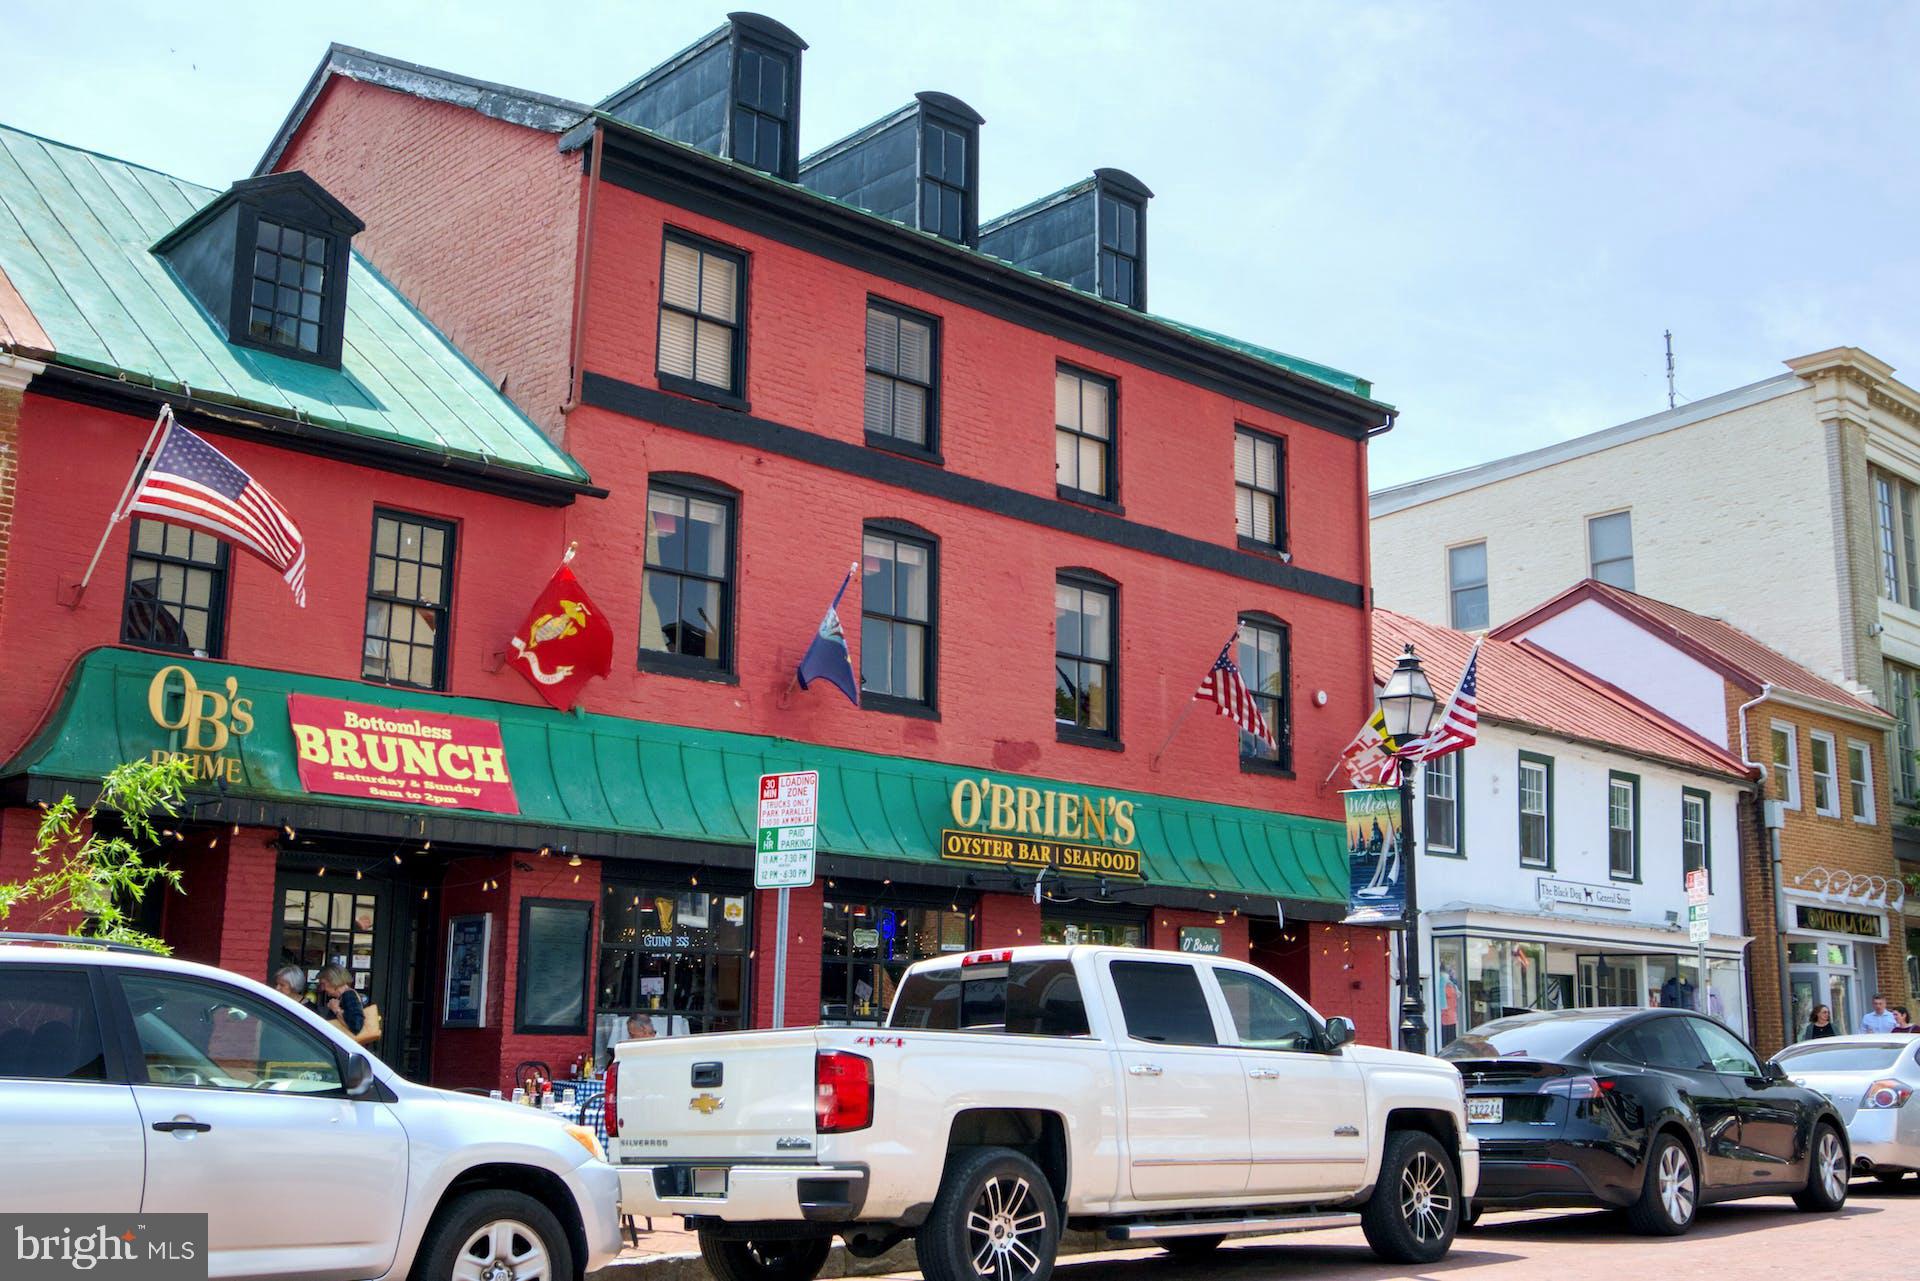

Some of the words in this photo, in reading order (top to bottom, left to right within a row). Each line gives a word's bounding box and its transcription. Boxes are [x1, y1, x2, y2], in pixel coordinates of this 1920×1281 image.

[344, 711, 452, 740] Bottomless
[292, 724, 509, 783] BRUNCH
[333, 771, 405, 788] Saturday
[410, 780, 420, 788] &
[424, 781, 481, 797] Sunday
[765, 779, 776, 789] 30
[781, 776, 815, 788] LOADING
[369, 787, 404, 798] 8am
[406, 791, 422, 800] to
[423, 793, 458, 805] 2pm
[763, 789, 777, 799] MIN
[787, 787, 808, 798] ZONE
[767, 801, 791, 809] TRUCKS
[793, 799, 809, 808] ONLY
[1350, 793, 1399, 814] Welcome
[762, 809, 779, 817] PARK
[781, 807, 812, 817] PARALLEL
[951, 778, 1135, 845] O'BRIEN'S
[766, 831, 772, 841] 2
[788, 828, 805, 838] PAID
[763, 841, 774, 851] HR
[781, 839, 811, 849] PARKING
[770, 855, 778, 863] AM
[800, 853, 807, 862] PM
[948, 835, 1013, 858] OYSTER
[1018, 843, 1050, 862] BAR
[1063, 848, 1135, 871] SEAFOOD
[770, 870, 778, 879] PM
[799, 868, 807, 878] PM
[1541, 884, 1552, 895] The
[1553, 885, 1568, 898] Black
[1570, 888, 1583, 902] Dog
[643, 934, 690, 948] GUINNSS
[1183, 936, 1220, 952] O'Brien's
[620, 1139, 668, 1147] SILVERADO
